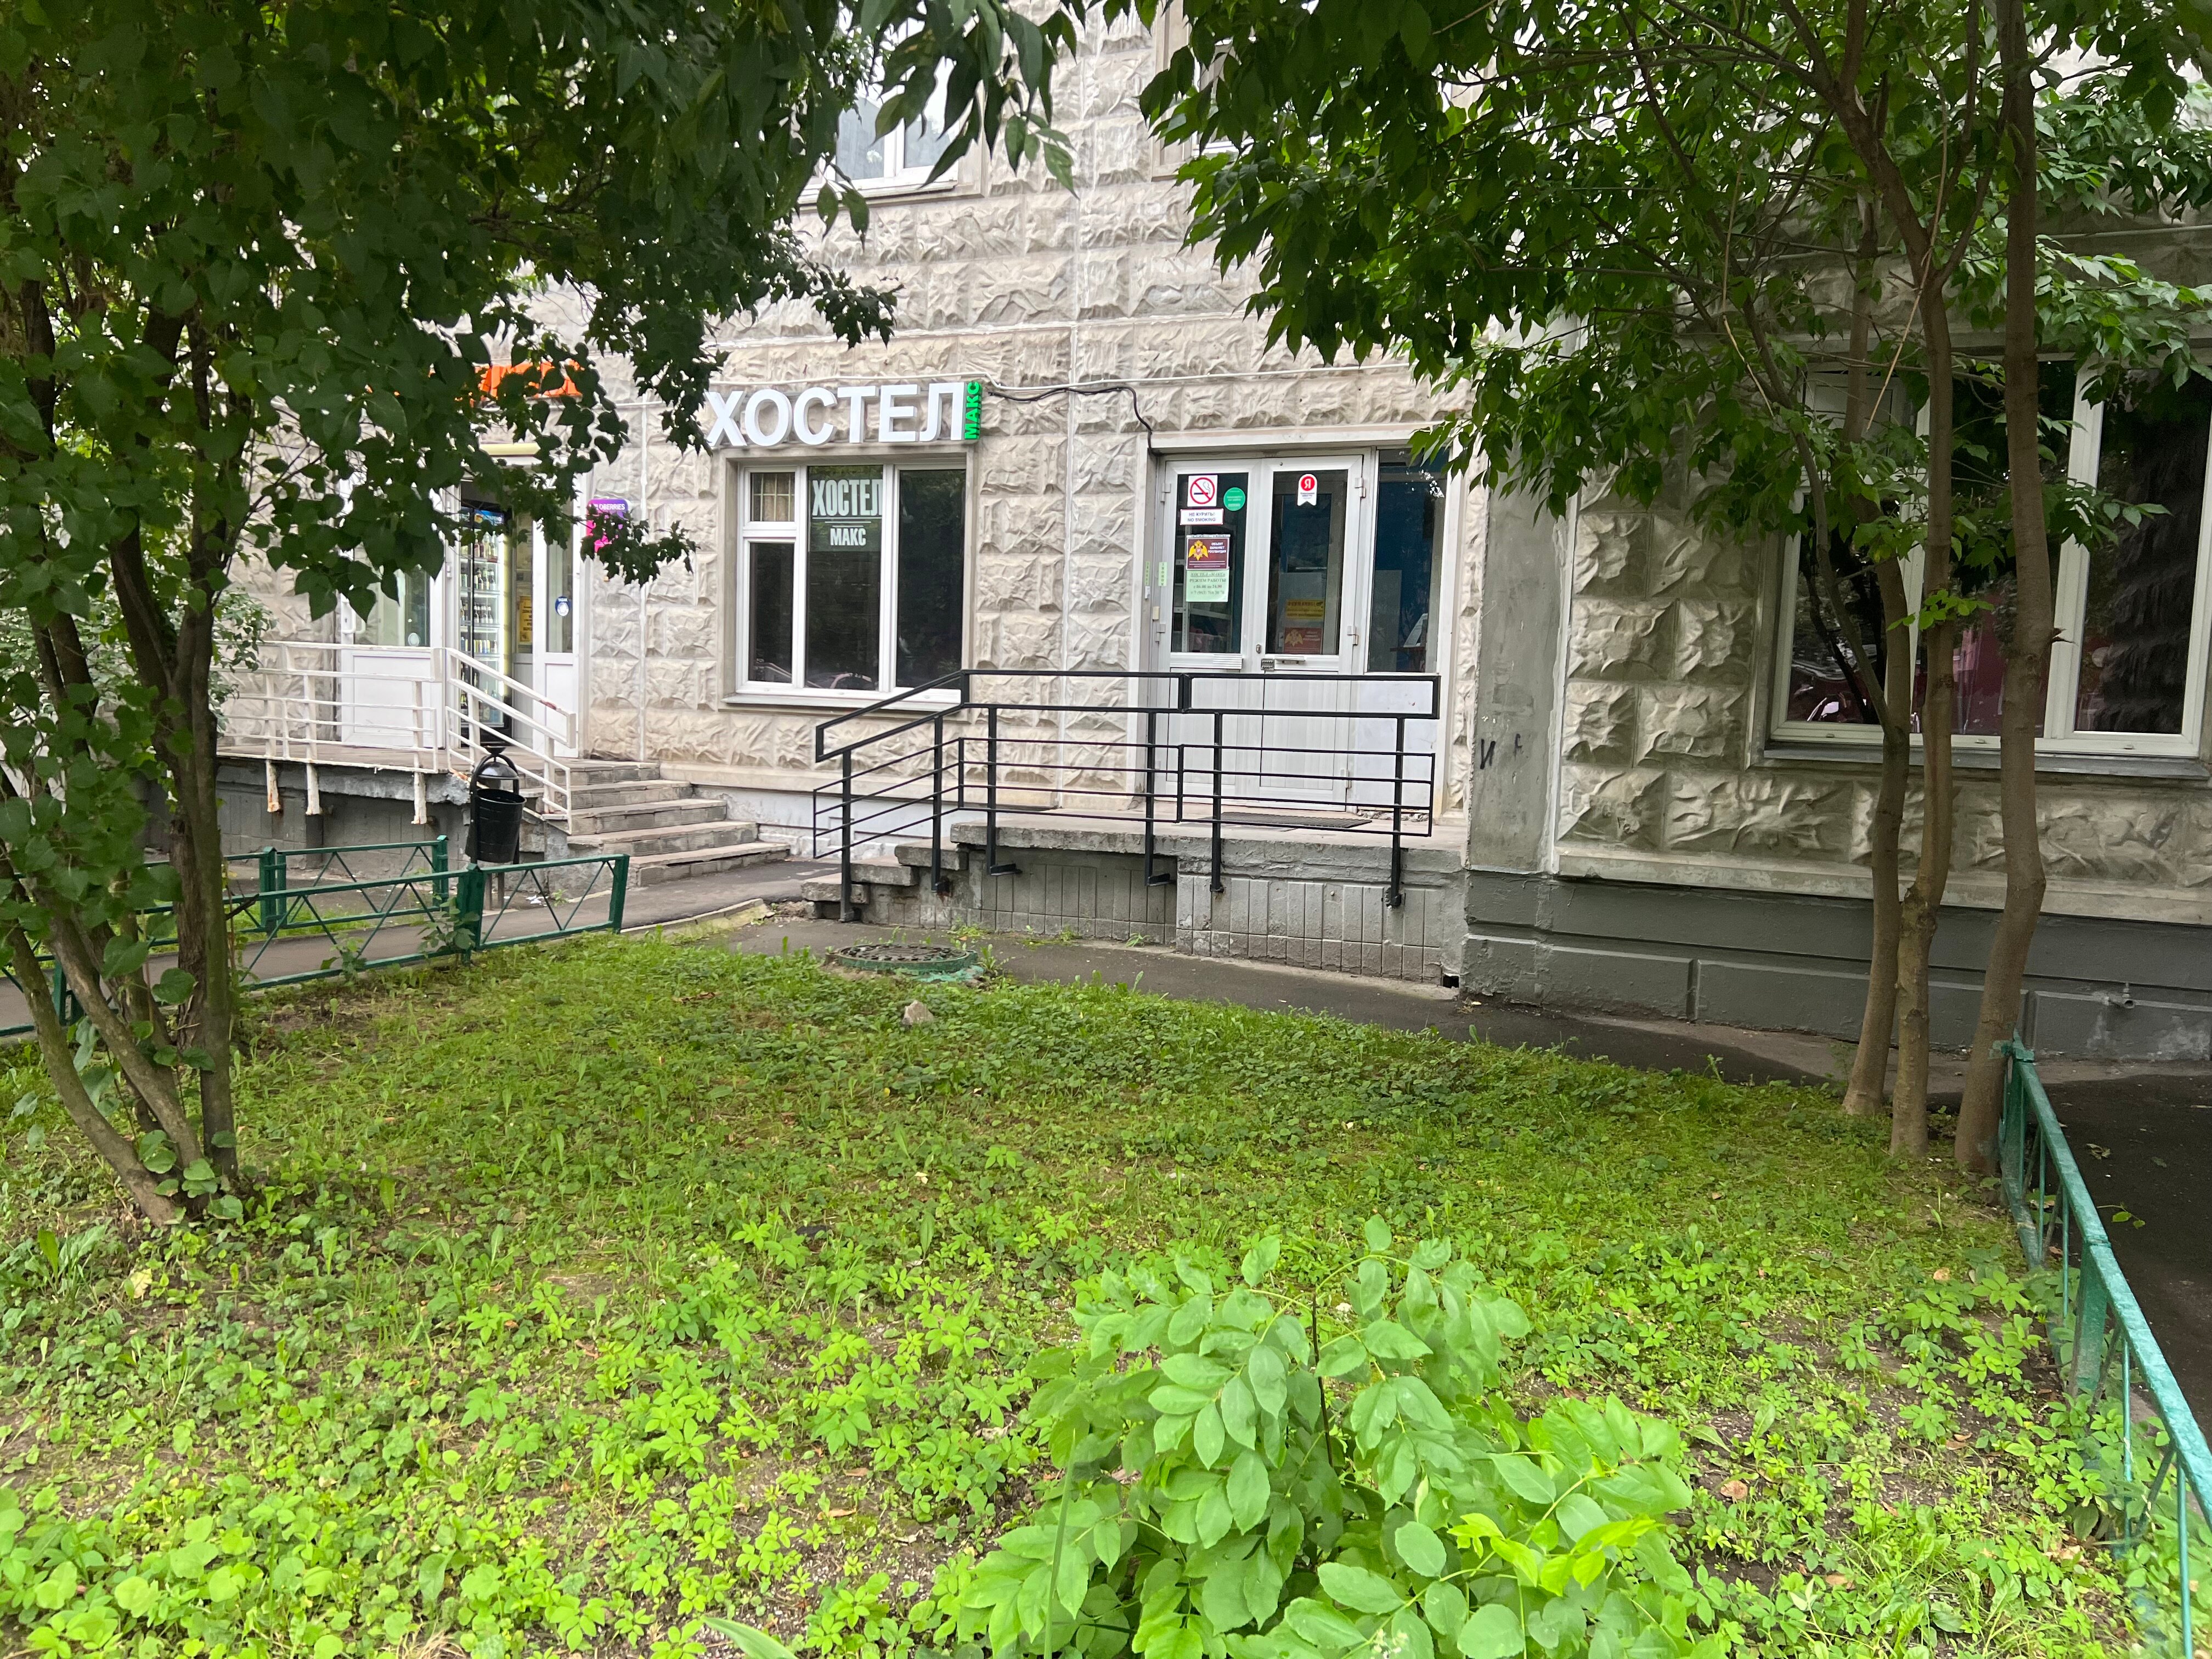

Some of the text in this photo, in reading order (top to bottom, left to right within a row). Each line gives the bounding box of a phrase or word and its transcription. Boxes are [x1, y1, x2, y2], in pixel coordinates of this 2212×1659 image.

[704, 382, 967, 447] ХОСТЕЛ
[964, 381, 983, 440] МАКС
[812, 478, 883, 517] ХОСТЕЛ
[1304, 478, 1312, 489] Я
[830, 527, 866, 546] МАКС
